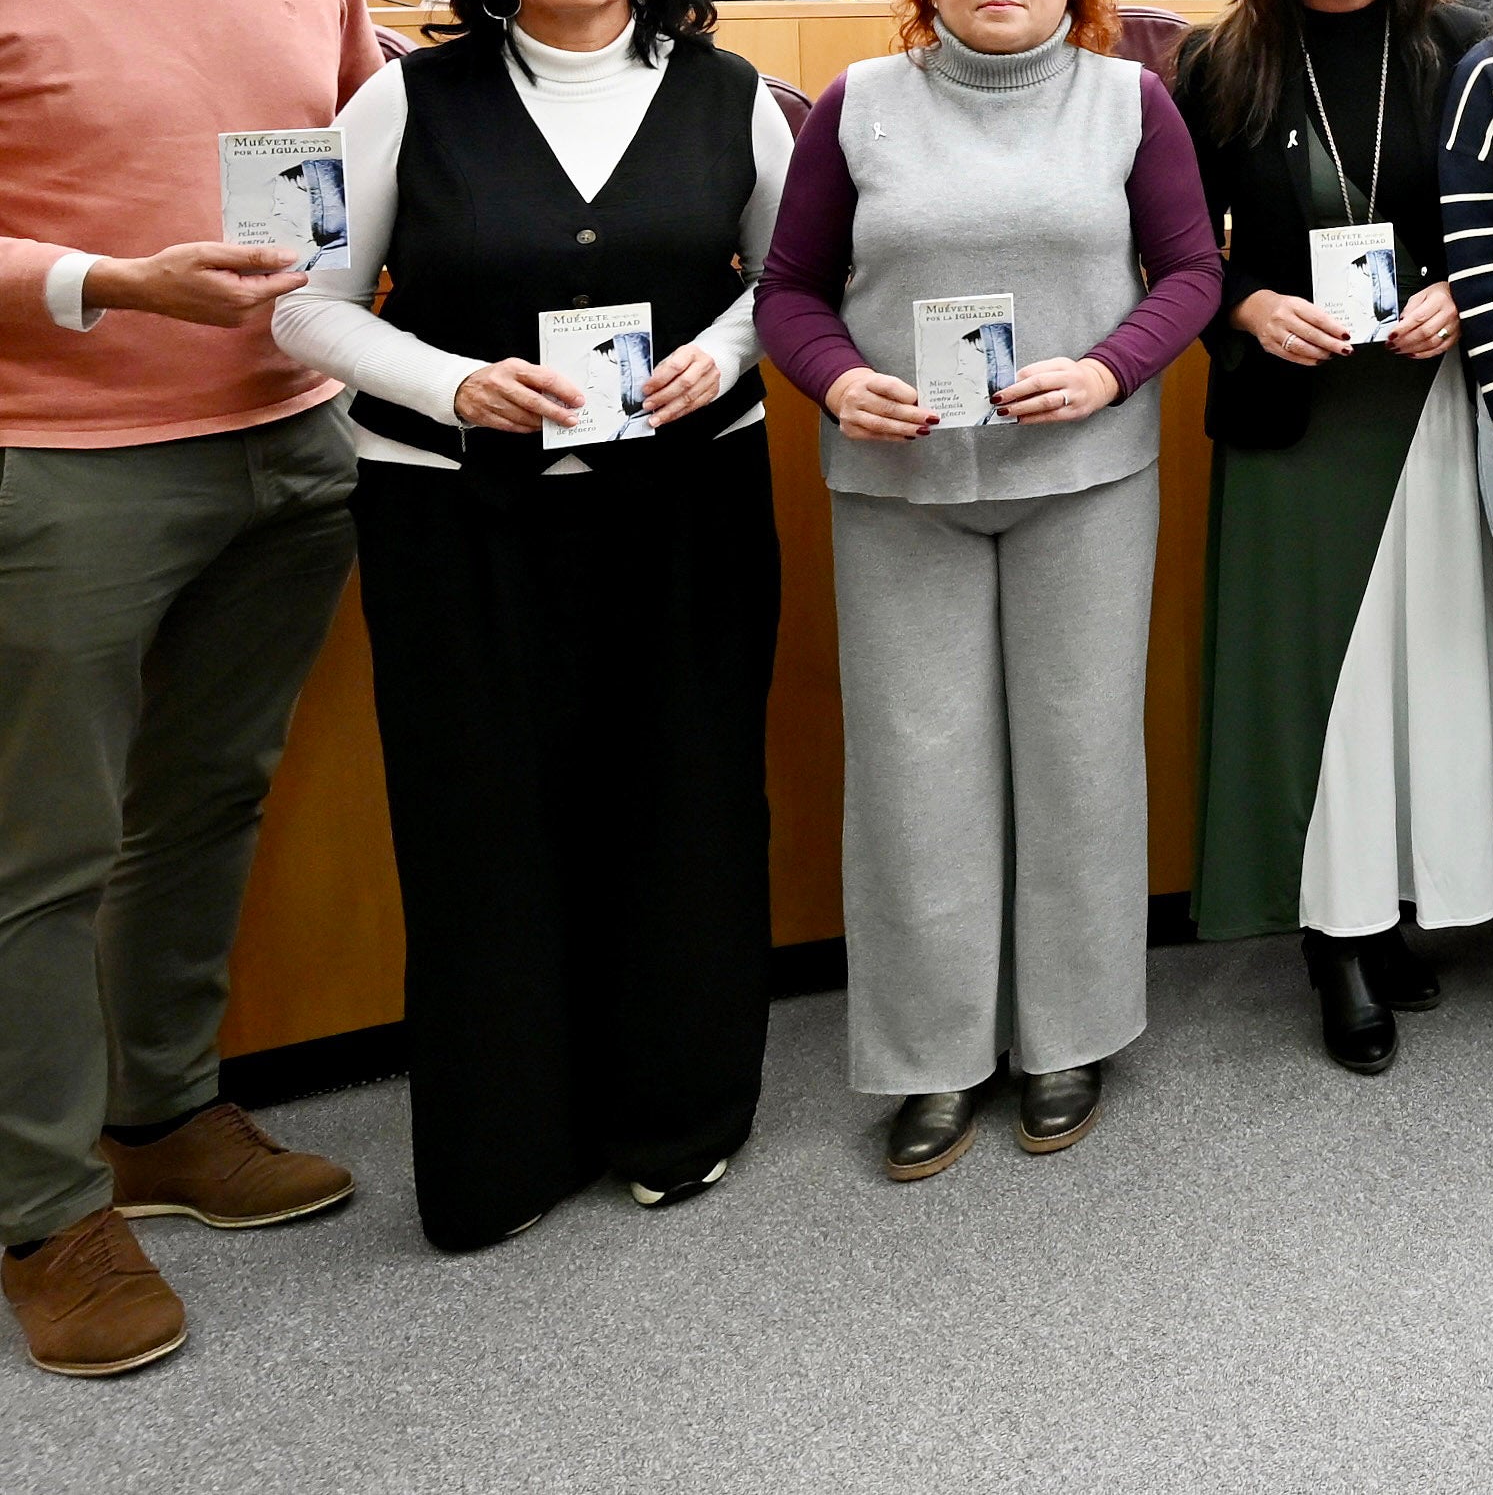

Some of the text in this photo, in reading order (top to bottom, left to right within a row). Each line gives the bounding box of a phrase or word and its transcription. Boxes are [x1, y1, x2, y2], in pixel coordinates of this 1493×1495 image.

[271, 146, 331, 154] IGUALDAD
[955, 311, 1004, 319] IGUALDAD
[586, 320, 640, 330] IGUALDAD
[568, 426, 596, 436] género
